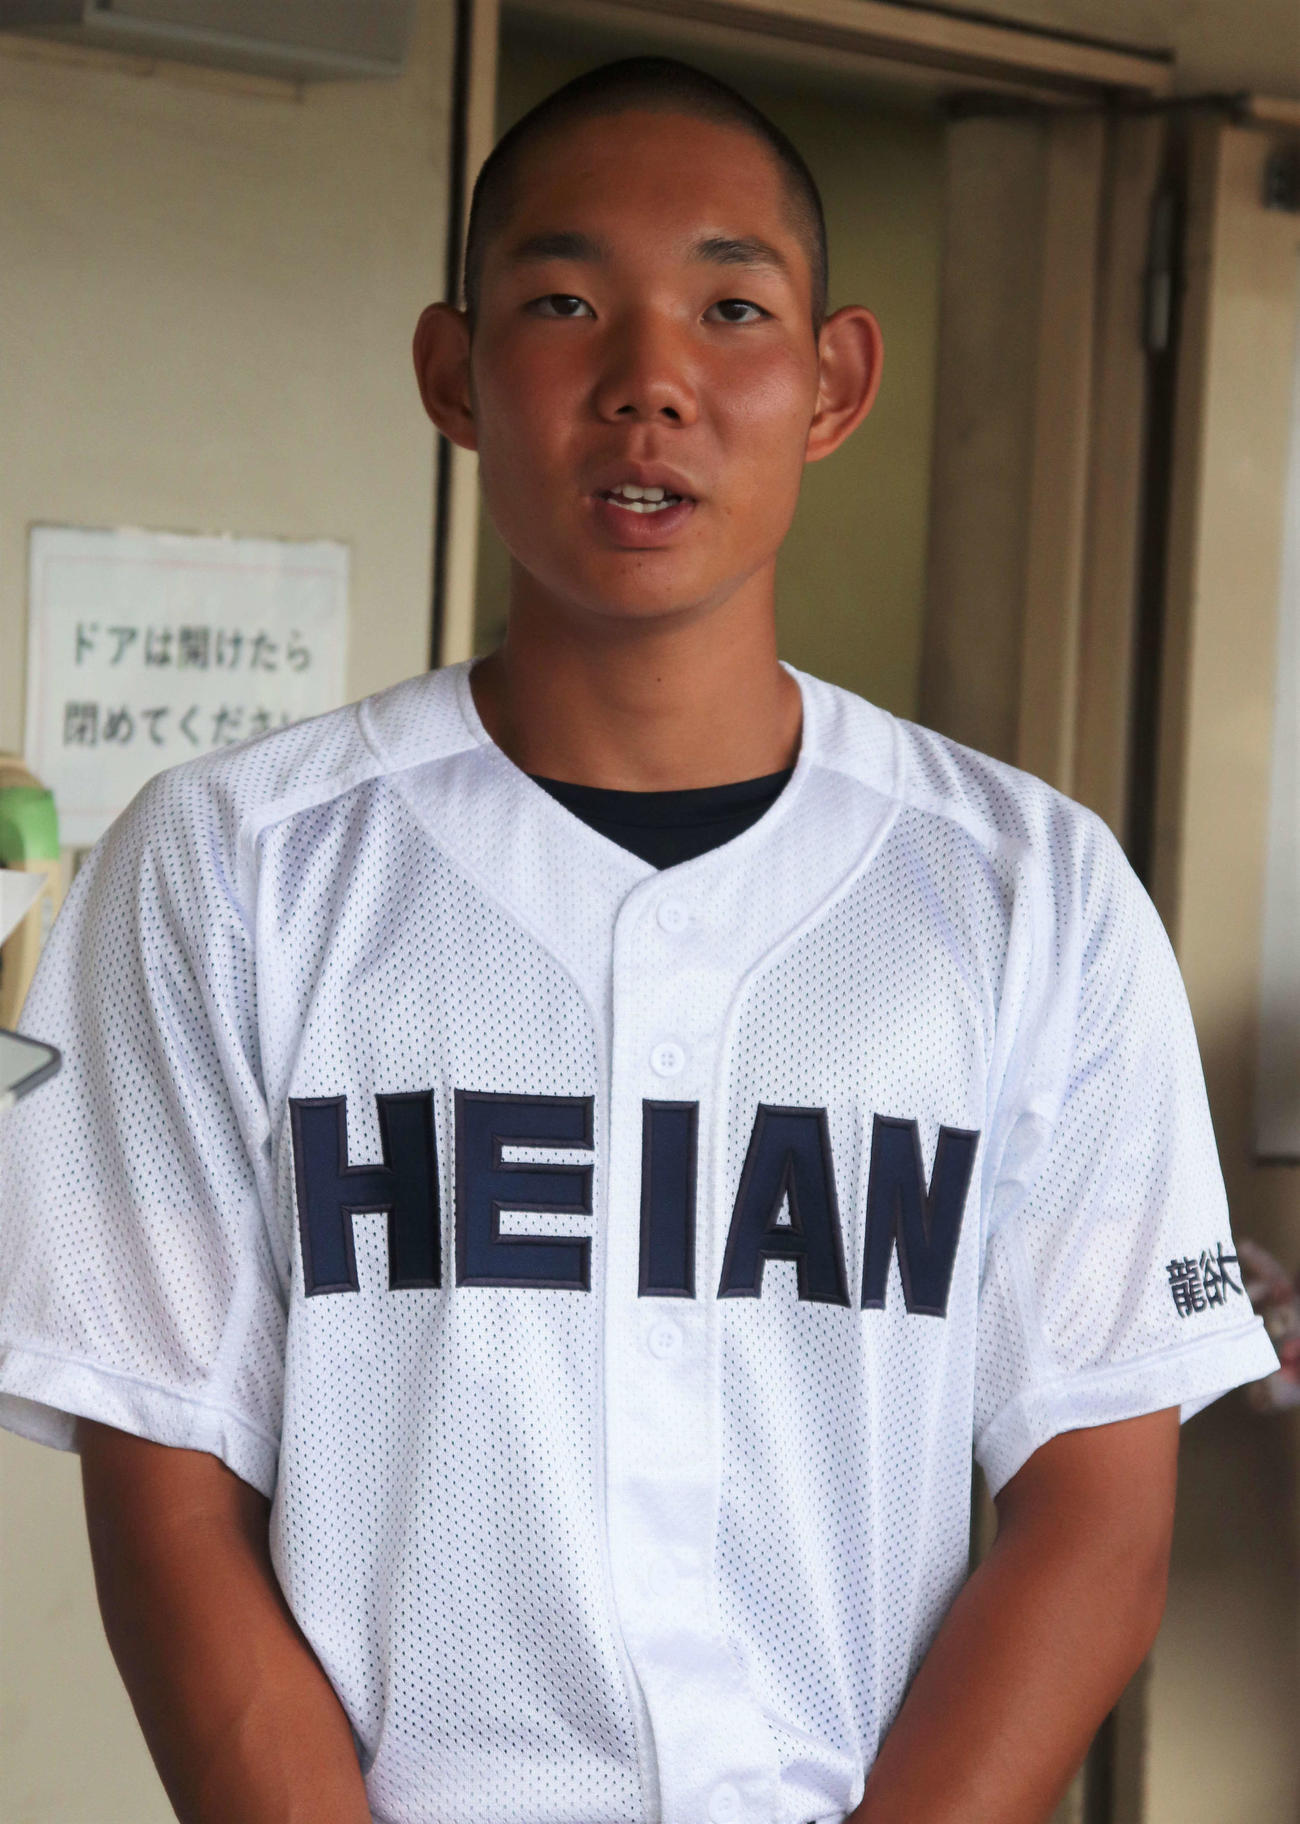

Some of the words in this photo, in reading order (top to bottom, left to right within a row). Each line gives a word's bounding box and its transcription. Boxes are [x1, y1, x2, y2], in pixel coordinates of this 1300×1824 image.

[74, 621, 312, 672] ドアは開けたら
[288, 1088, 981, 1318] HEIAN
